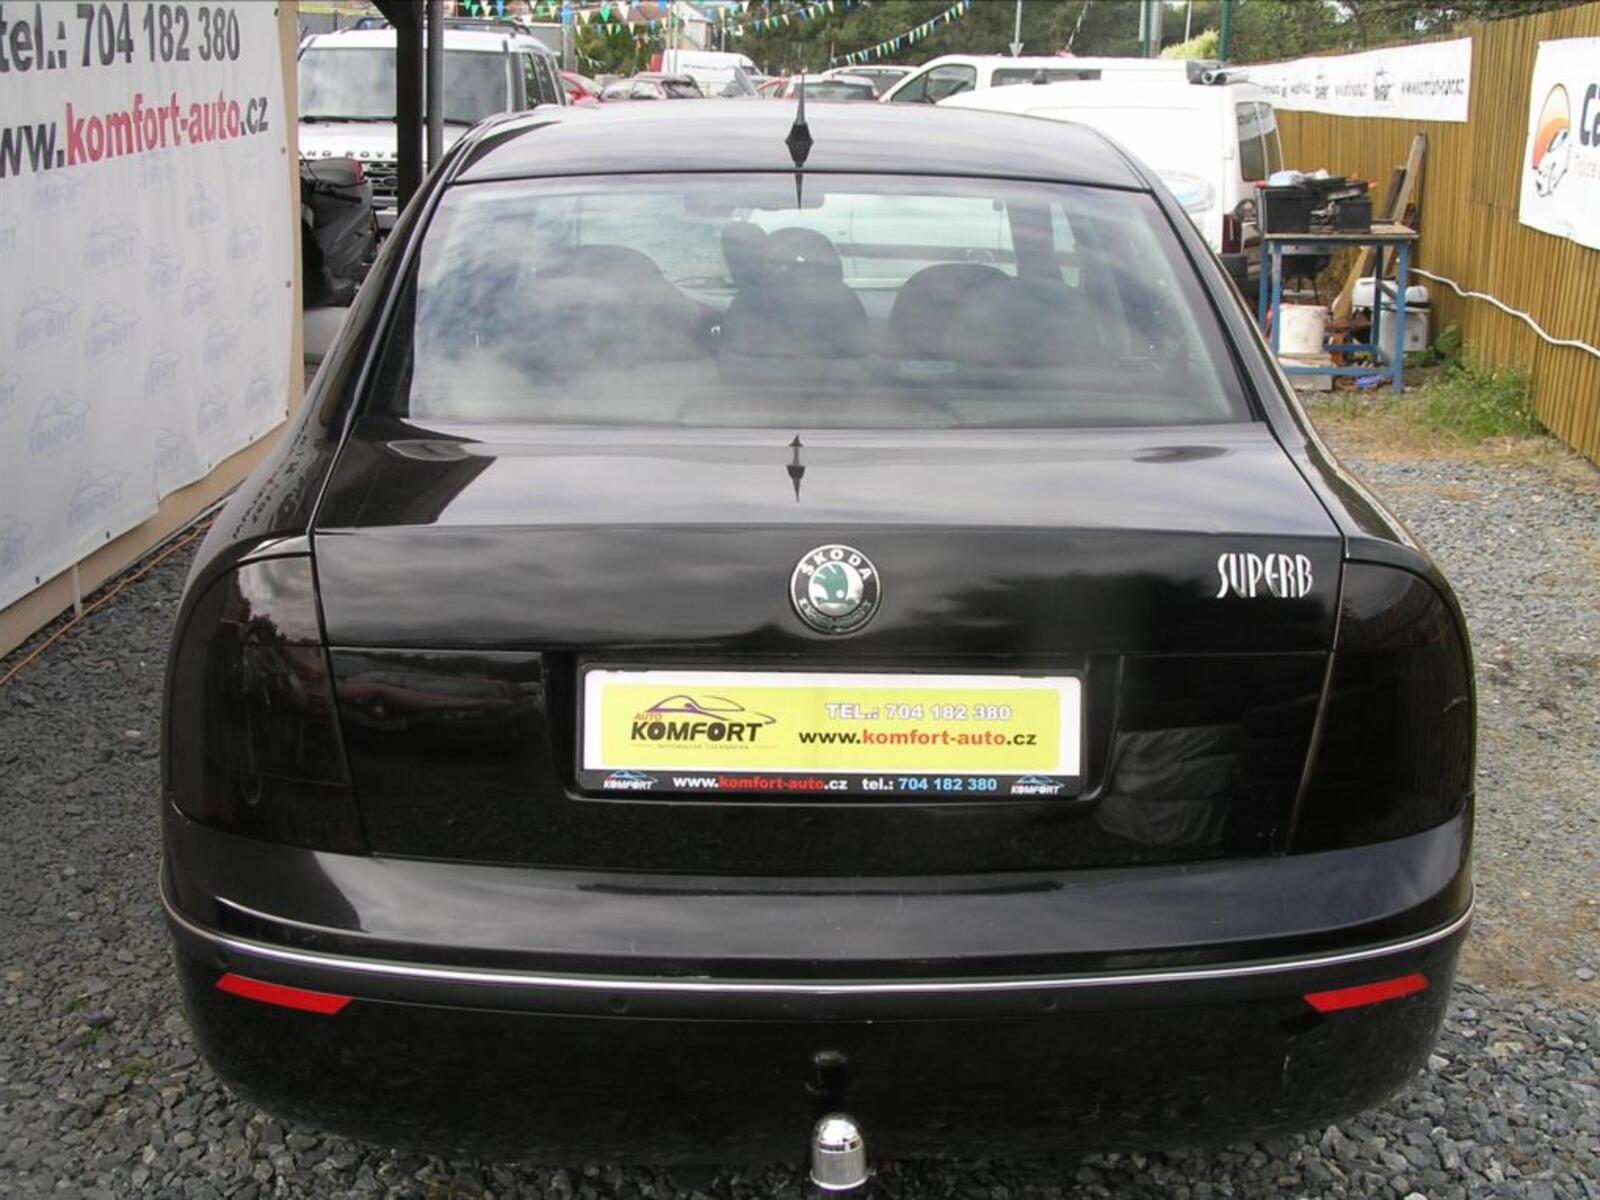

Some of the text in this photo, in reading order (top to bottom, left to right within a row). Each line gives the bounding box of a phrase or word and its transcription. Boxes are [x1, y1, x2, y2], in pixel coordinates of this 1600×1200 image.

[76, 3, 134, 67] 704
[143, 4, 190, 62] 182
[198, 7, 241, 61] 380
[1216, 552, 1313, 598] SUPERB
[633, 713, 663, 721] AUTO
[825, 704, 1012, 721] TEL.: 704 182 380
[631, 721, 763, 742] KOMFORT
[798, 729, 1037, 746] www.komfort-auto.cz
[603, 779, 654, 790] KOMFORT
[672, 775, 998, 791] www.komfort-auto.cz tel.: 704 182 380
[1010, 785, 1060, 795] KOMFORT
